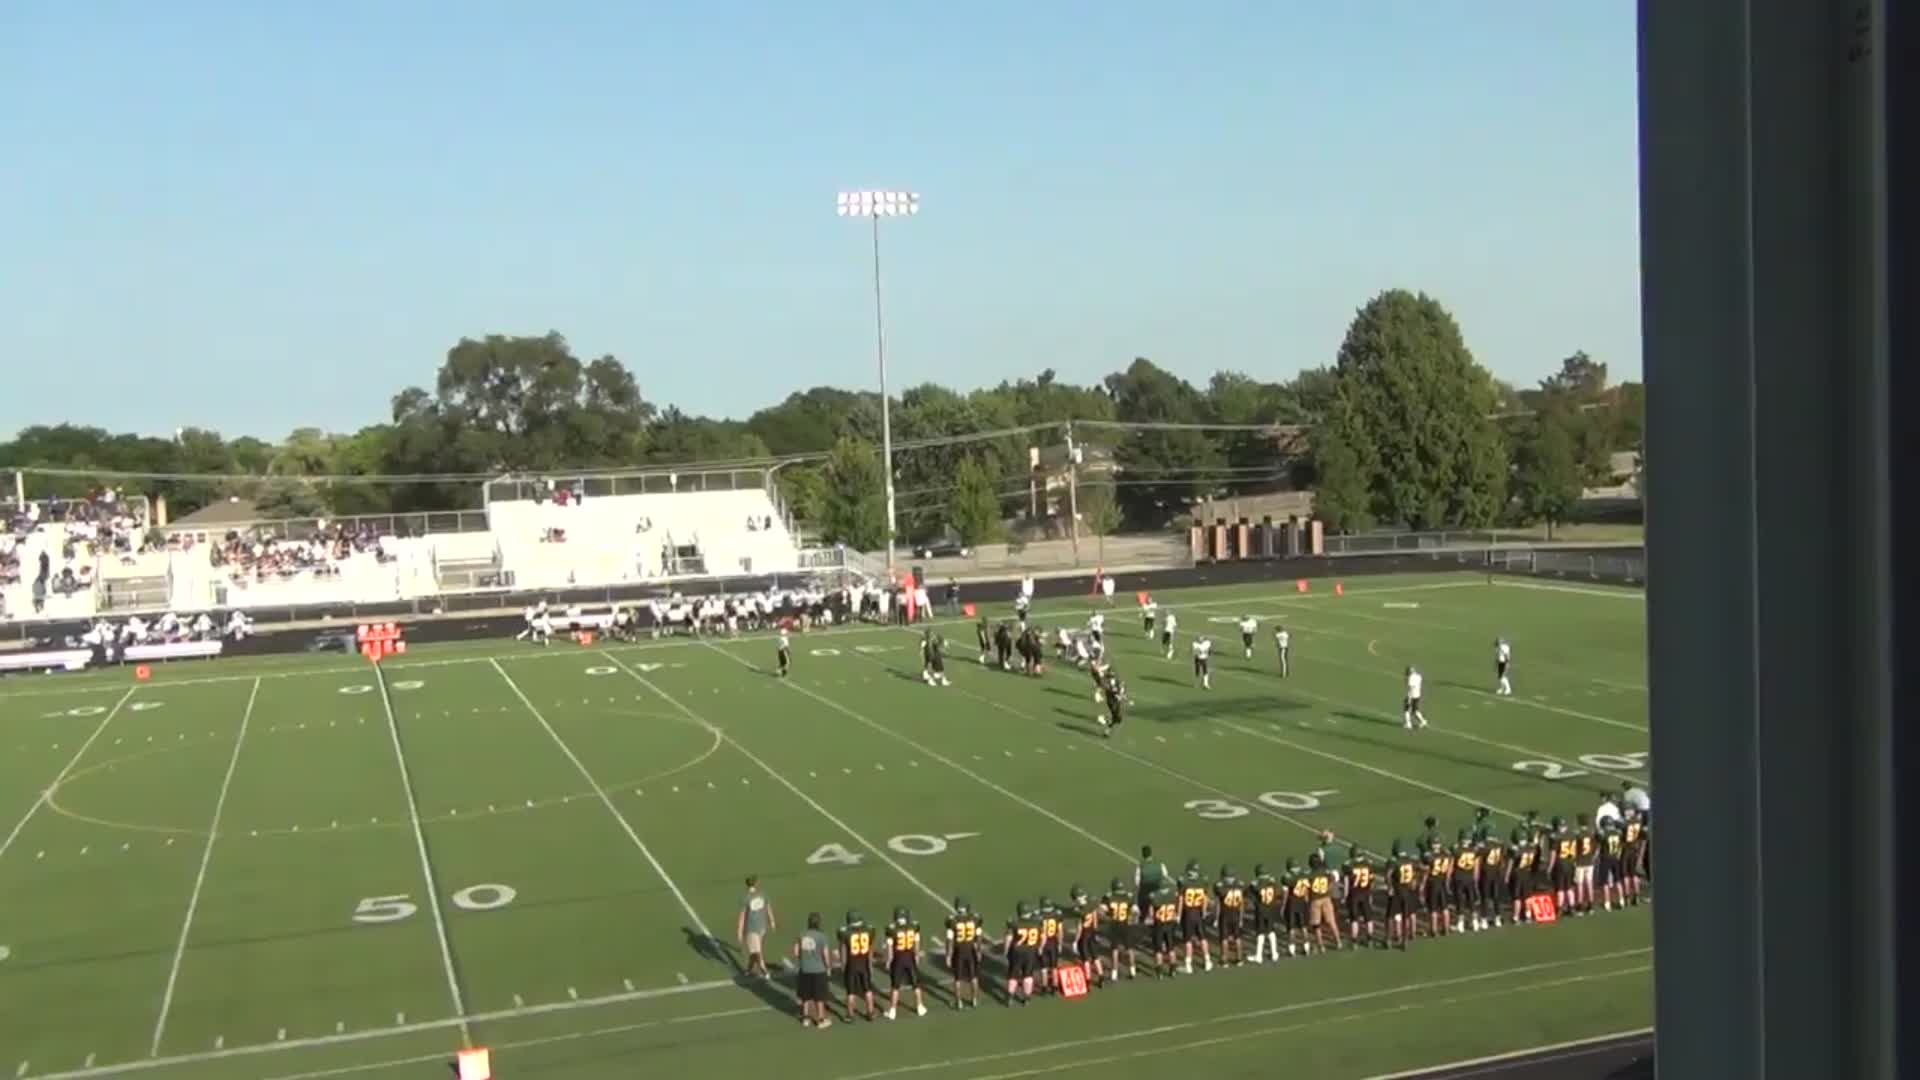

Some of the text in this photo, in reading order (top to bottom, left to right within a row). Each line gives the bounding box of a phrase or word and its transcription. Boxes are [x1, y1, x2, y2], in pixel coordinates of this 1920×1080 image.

[1512, 753, 1644, 780] 20
[1184, 791, 1321, 820] 30
[805, 834, 948, 866] 40
[1353, 867, 1370, 888] 73
[352, 883, 518, 924] 50
[1185, 887, 1204, 908] 82
[1534, 898, 1554, 919] 30
[956, 920, 977, 943] 33
[1062, 967, 1086, 994] 40
